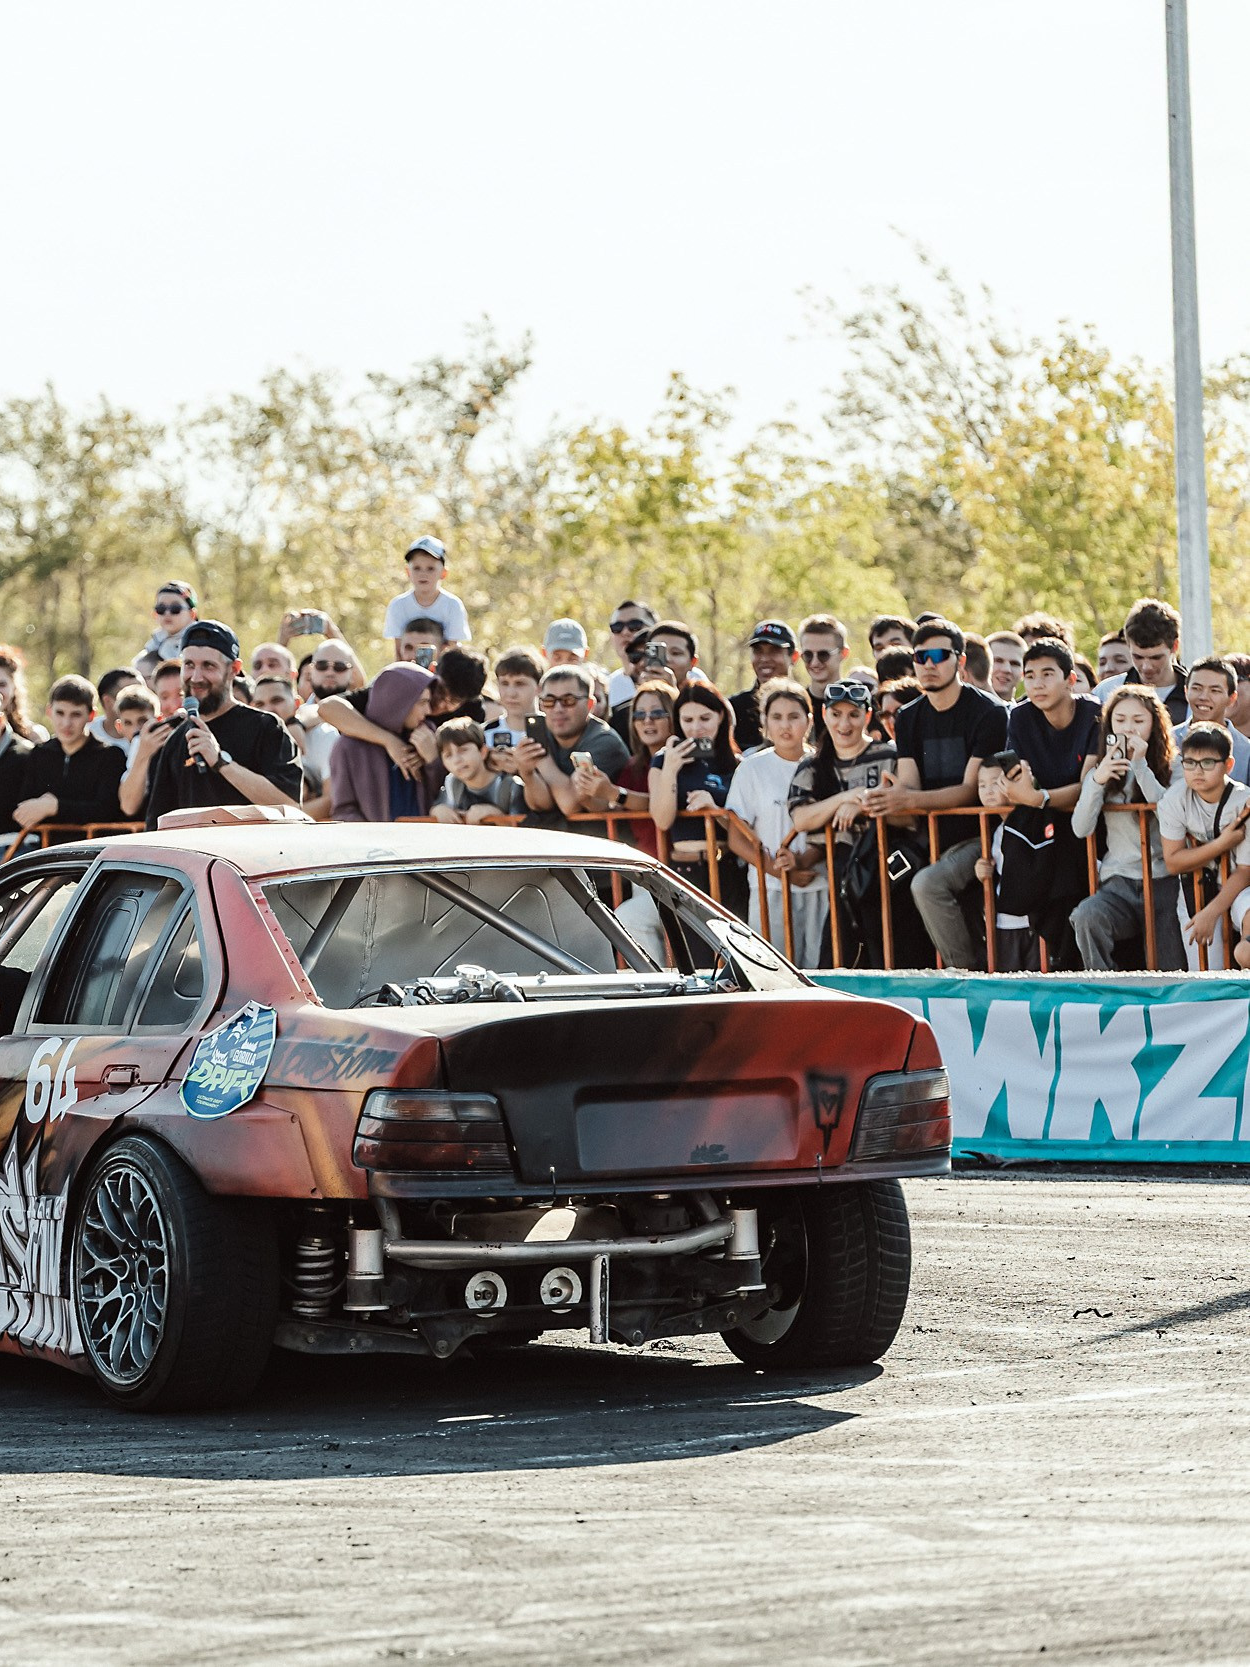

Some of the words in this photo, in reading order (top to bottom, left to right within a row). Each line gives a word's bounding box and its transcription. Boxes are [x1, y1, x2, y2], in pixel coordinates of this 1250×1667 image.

[25, 1036, 82, 1124] 64
[187, 1059, 258, 1101] DRIFT
[232, 1049, 257, 1066] GORILLA
[883, 997, 1250, 1141] WKZ
